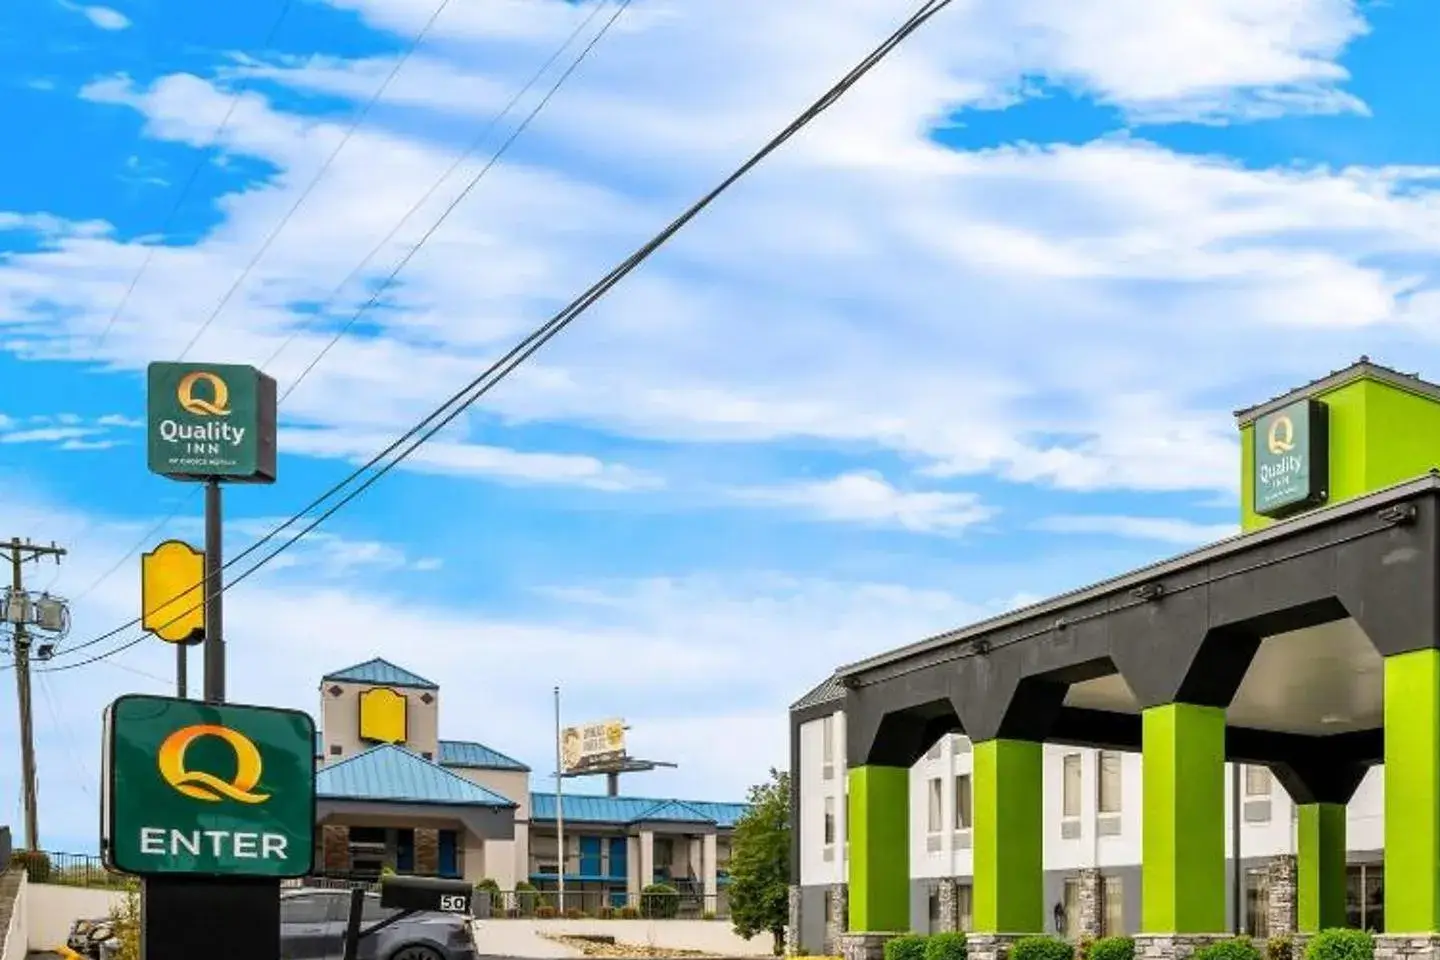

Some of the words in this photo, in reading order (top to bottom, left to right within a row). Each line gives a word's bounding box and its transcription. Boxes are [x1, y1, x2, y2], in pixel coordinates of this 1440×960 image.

[177, 371, 231, 416] Q
[160, 420, 245, 446] Quality
[187, 443, 219, 454] INN
[1268, 415, 1296, 455] Q
[1260, 455, 1302, 484] Quality
[159, 724, 271, 804] Q
[140, 827, 288, 860] ENTER
[443, 896, 464, 909] 50
